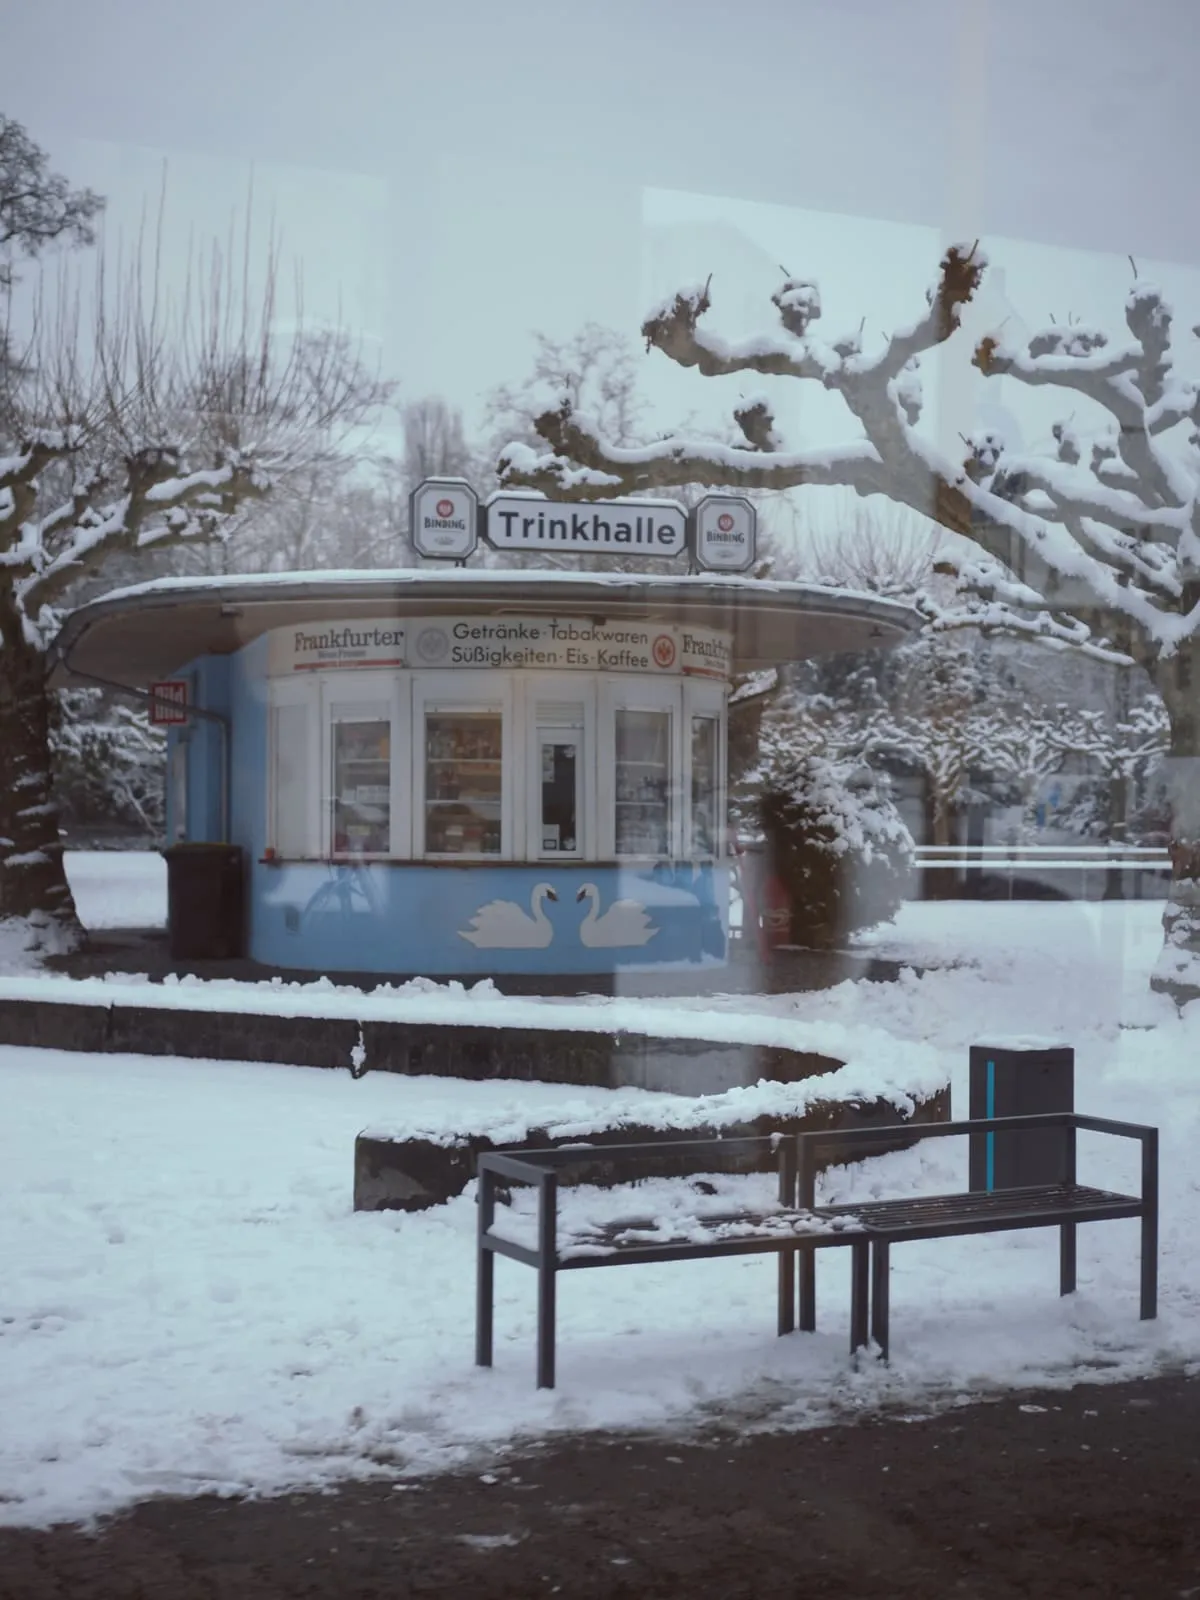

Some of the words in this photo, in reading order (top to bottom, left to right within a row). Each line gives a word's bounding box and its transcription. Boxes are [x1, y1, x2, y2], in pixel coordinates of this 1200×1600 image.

[424, 517, 466, 531] BINDING
[498, 511, 676, 545] Trinkhalle
[294, 627, 404, 651] Frankfurter
[453, 622, 540, 640] Getränke
[550, 624, 648, 645] Tabakwaren
[451, 645, 557, 666] Süßigkeiten
[566, 651, 589, 664] Eis
[597, 650, 649, 668] Kaffee
